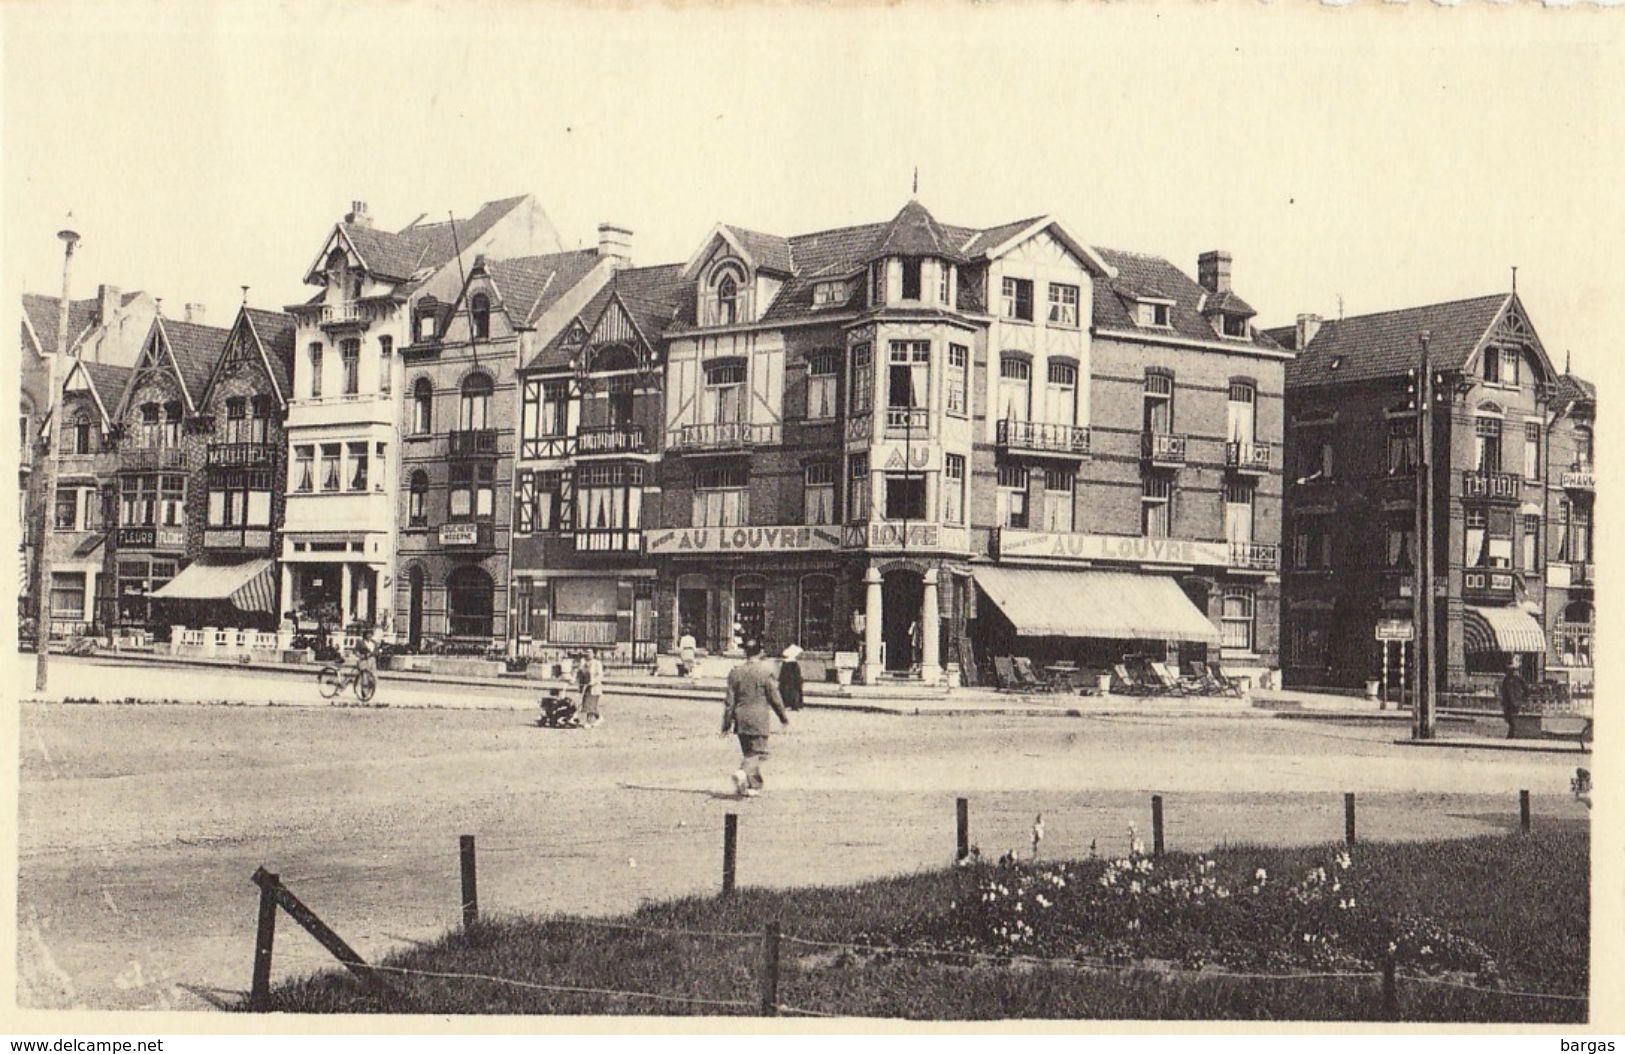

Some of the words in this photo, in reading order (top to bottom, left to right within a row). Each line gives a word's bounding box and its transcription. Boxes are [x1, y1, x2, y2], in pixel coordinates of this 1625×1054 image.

[884, 447, 930, 468] AU
[678, 529, 709, 549] AU
[719, 528, 811, 549] LOUVRE
[871, 524, 937, 546] LOUVRE
[1051, 535, 1084, 555] AU
[1101, 538, 1195, 561] LOUVRE
